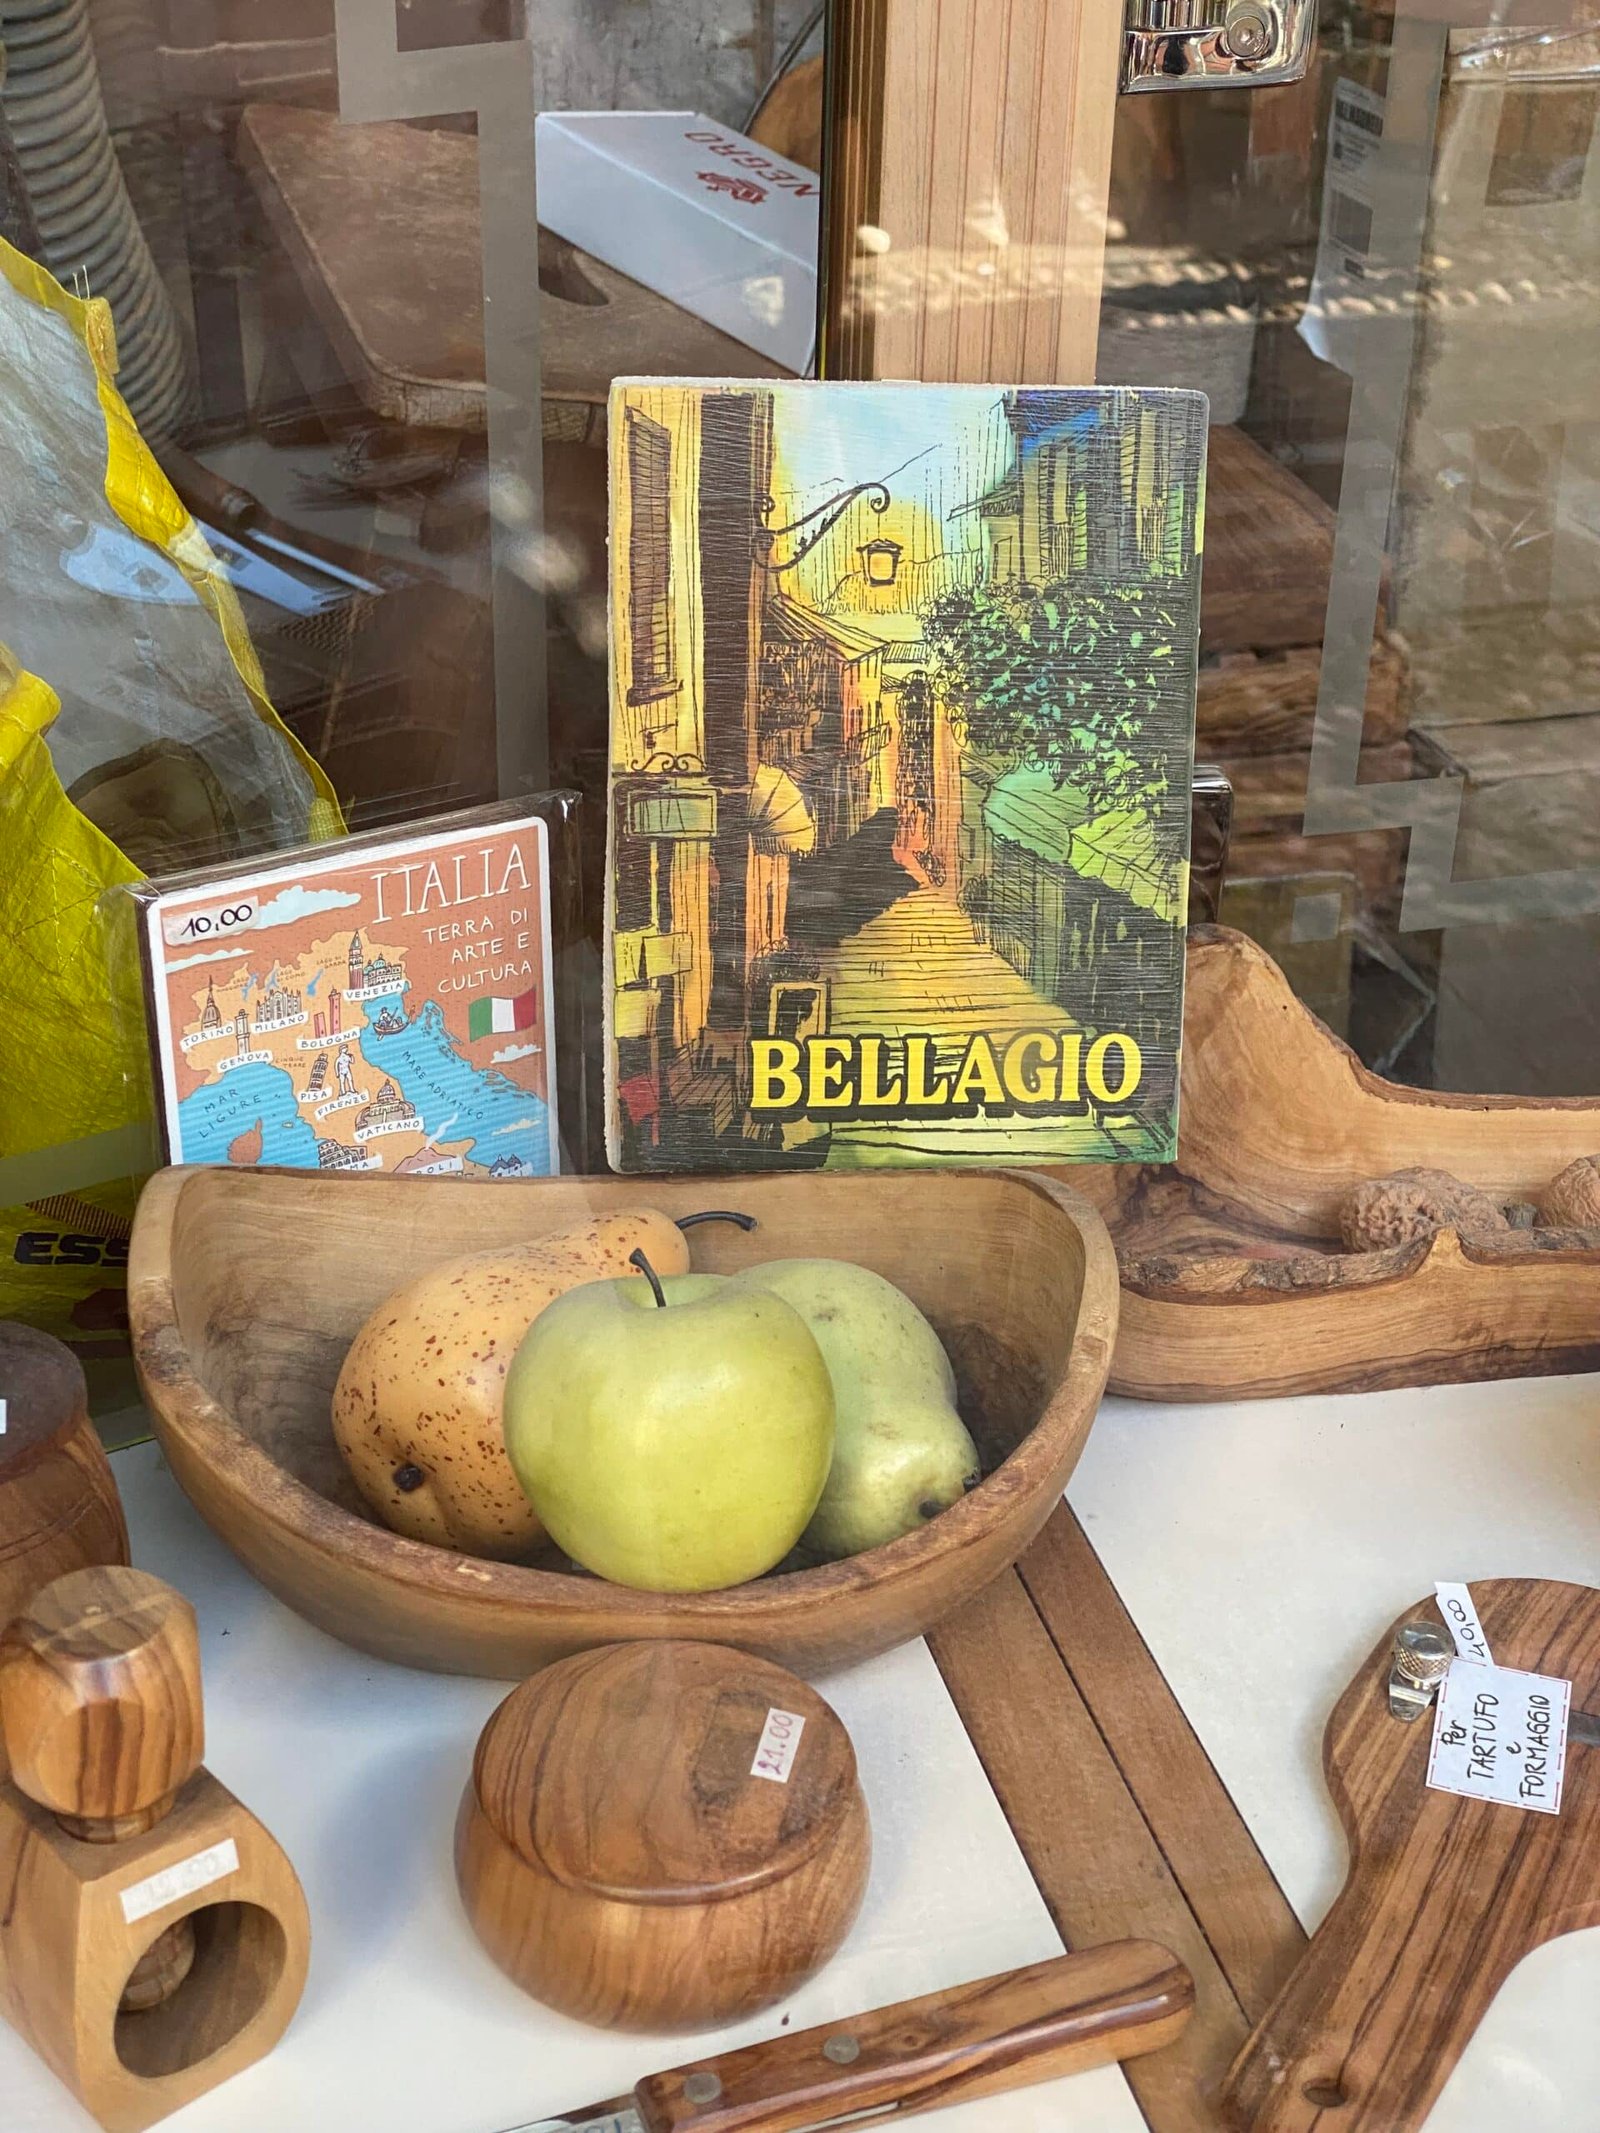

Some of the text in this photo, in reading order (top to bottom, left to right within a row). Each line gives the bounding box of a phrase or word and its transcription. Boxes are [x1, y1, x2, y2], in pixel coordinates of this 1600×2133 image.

[370, 843, 532, 924] ITALIA
[181, 905, 252, 936] 10,00
[422, 908, 528, 944] TERRA DI
[451, 932, 530, 964] ARTE E
[346, 983, 403, 999] VENEZIA
[438, 960, 532, 993] CULTURA
[183, 1026, 233, 1046] TORINO
[255, 1014, 305, 1031] MILANO
[301, 1031, 358, 1048] BOLOGNA
[220, 1052, 270, 1070] GENOVA
[750, 1032, 1143, 1109] BELLAGIO
[301, 1091, 327, 1101] PISA
[402, 1050, 483, 1120] MARE ADRIATICO
[204, 1088, 239, 1113] MAR
[318, 1093, 367, 1116] FIRENZE
[199, 1094, 261, 1139] LIGURE
[357, 1120, 420, 1139] VATICANO
[1440, 1719, 1467, 1746] Per
[1467, 1693, 1499, 1779] TARTUFO
[1519, 1694, 1550, 1798] FORMAGGIO
